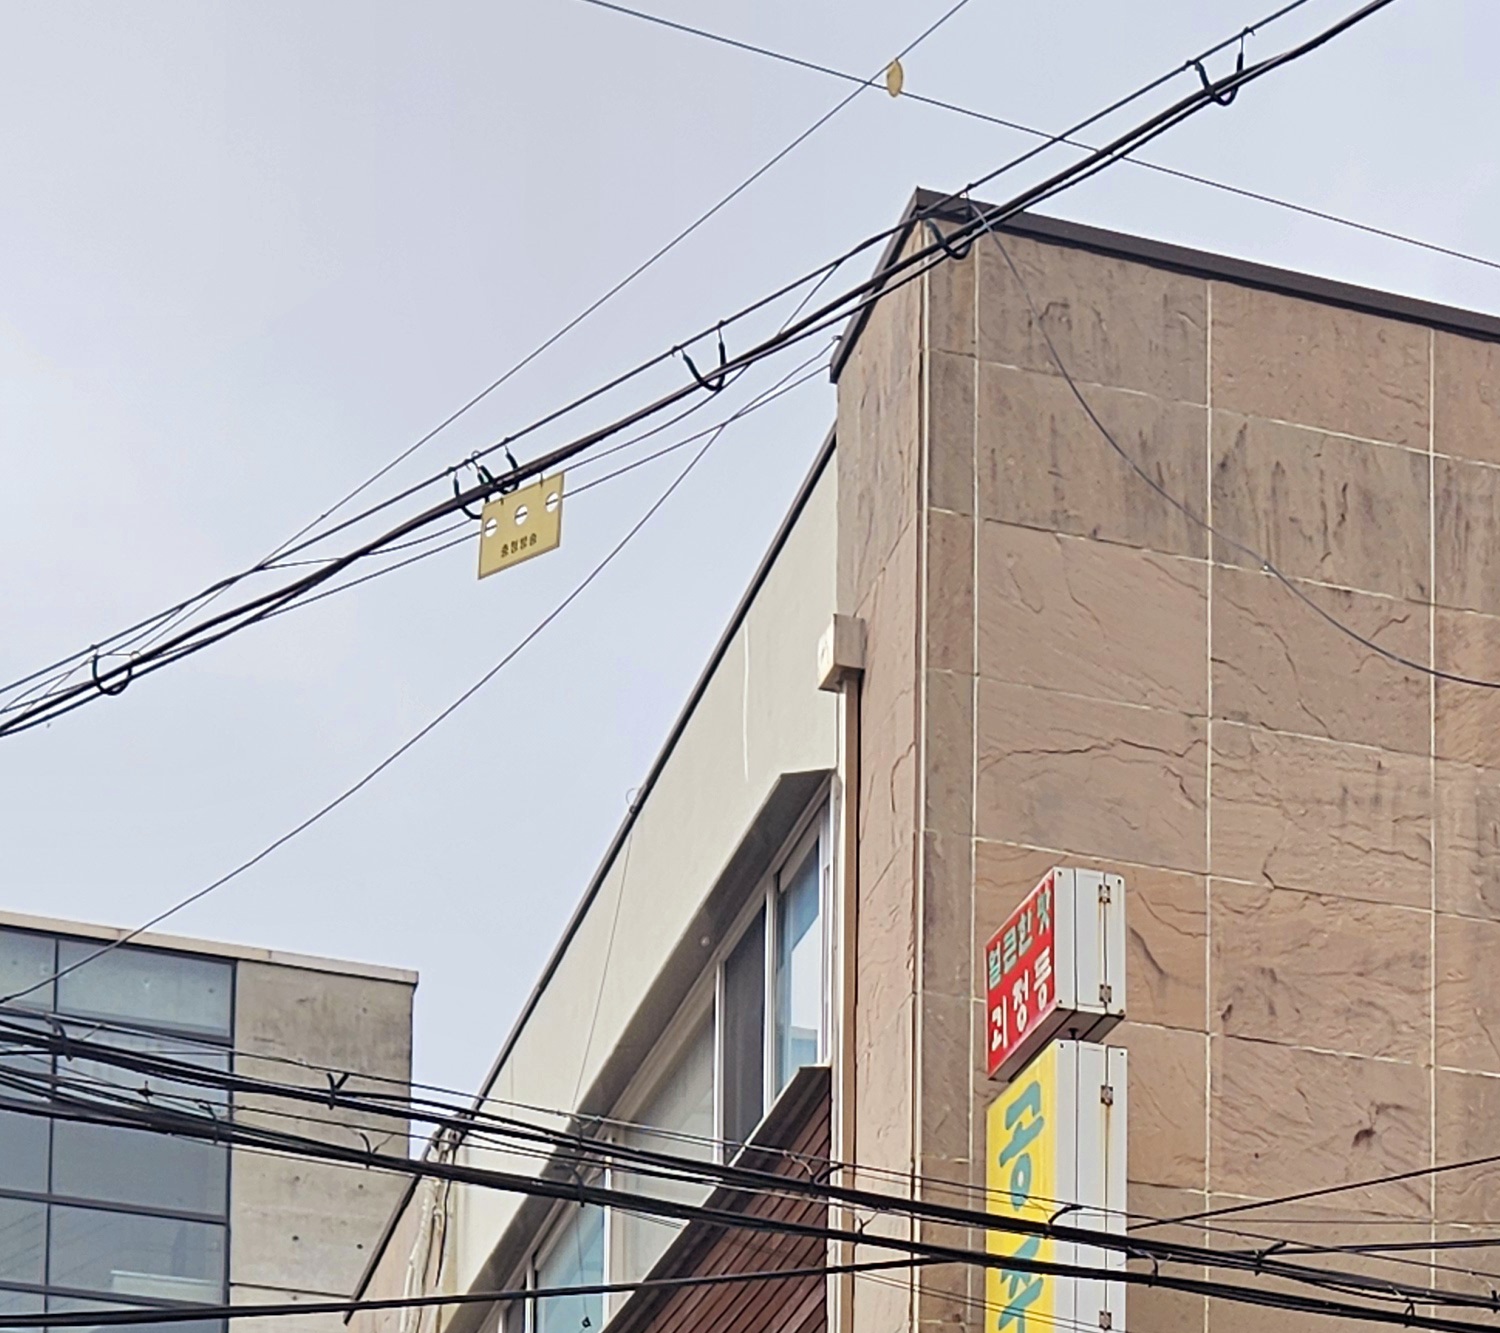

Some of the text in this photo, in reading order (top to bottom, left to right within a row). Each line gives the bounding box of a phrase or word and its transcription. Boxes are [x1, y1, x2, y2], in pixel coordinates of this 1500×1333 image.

[988, 878, 1052, 991] 얼큰한 맛
[991, 946, 1052, 1052] 괴정동
